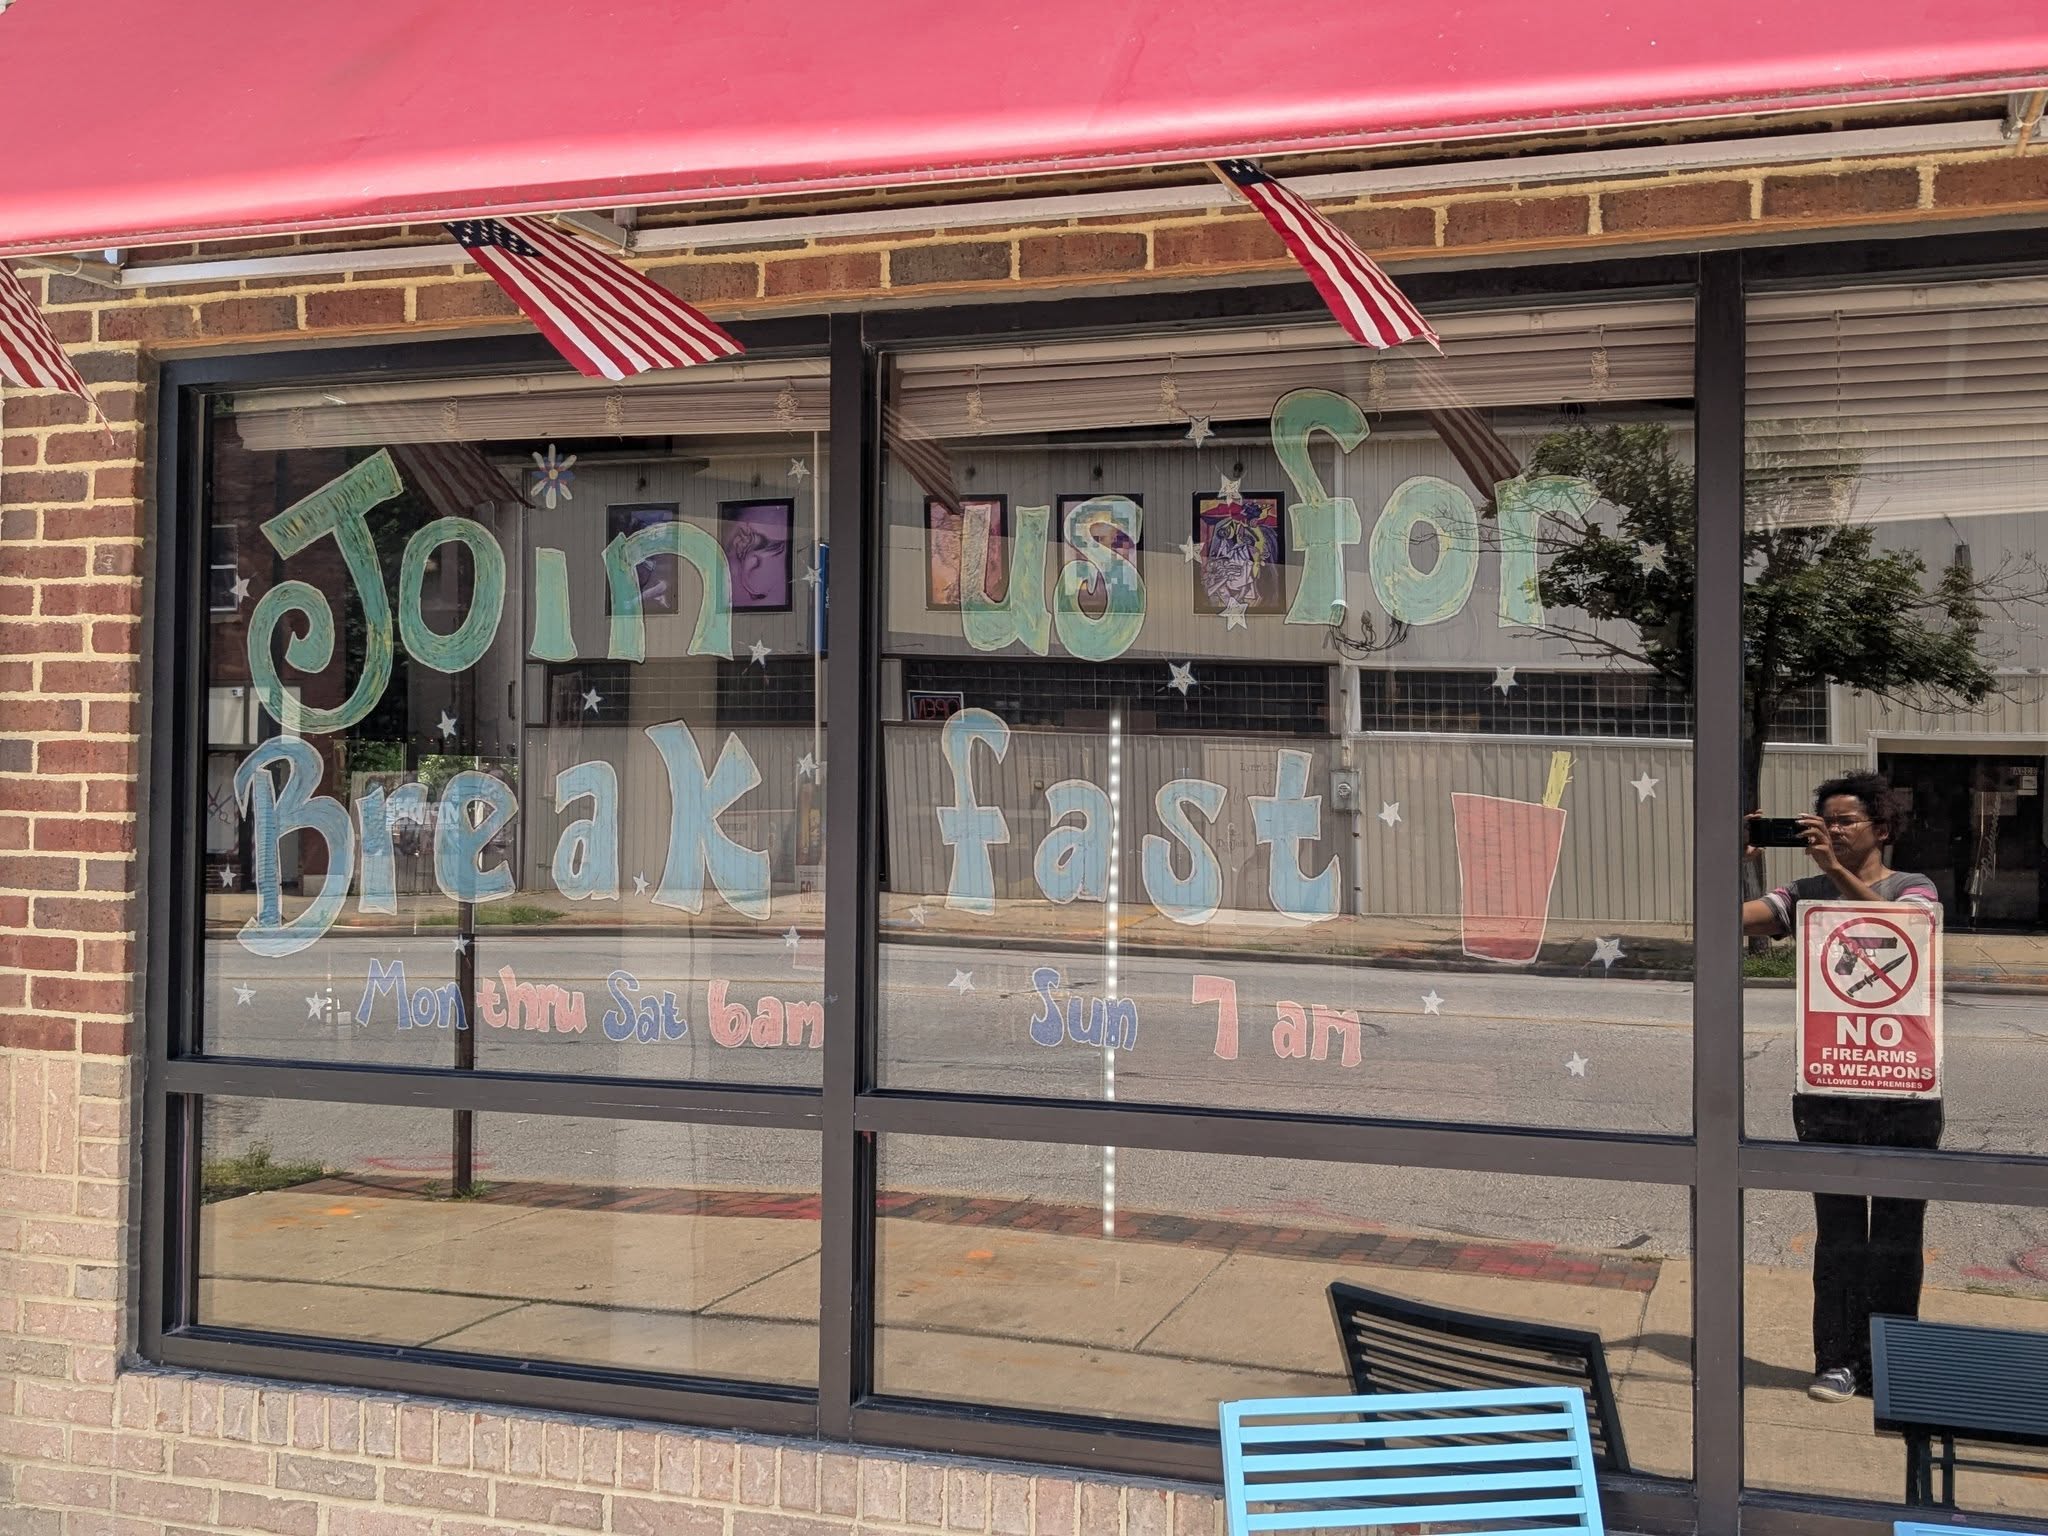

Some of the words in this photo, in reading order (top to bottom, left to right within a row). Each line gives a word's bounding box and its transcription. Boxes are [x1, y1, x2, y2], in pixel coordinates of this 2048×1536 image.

[246, 447, 734, 734] Join
[958, 495, 1147, 661] us
[1271, 388, 1601, 629] for
[936, 708, 1342, 925] fast
[355, 957, 469, 1030] Mon
[476, 965, 588, 1033] thru
[602, 969, 688, 1044] Sat
[1030, 967, 1139, 1050] Sun
[1192, 975, 1239, 1061] 7
[1272, 1001, 1362, 1068] am
[1822, 1047, 1918, 1064] FIREARMS
[1836, 1016, 1903, 1047] NO
[1809, 1062, 1834, 1076] OR
[1839, 1064, 1933, 1081] WEAPONS
[1816, 1077, 1859, 1087] ALLOWED
[1861, 1078, 1875, 1088] ON
[1876, 1079, 1923, 1090] PREMISES
